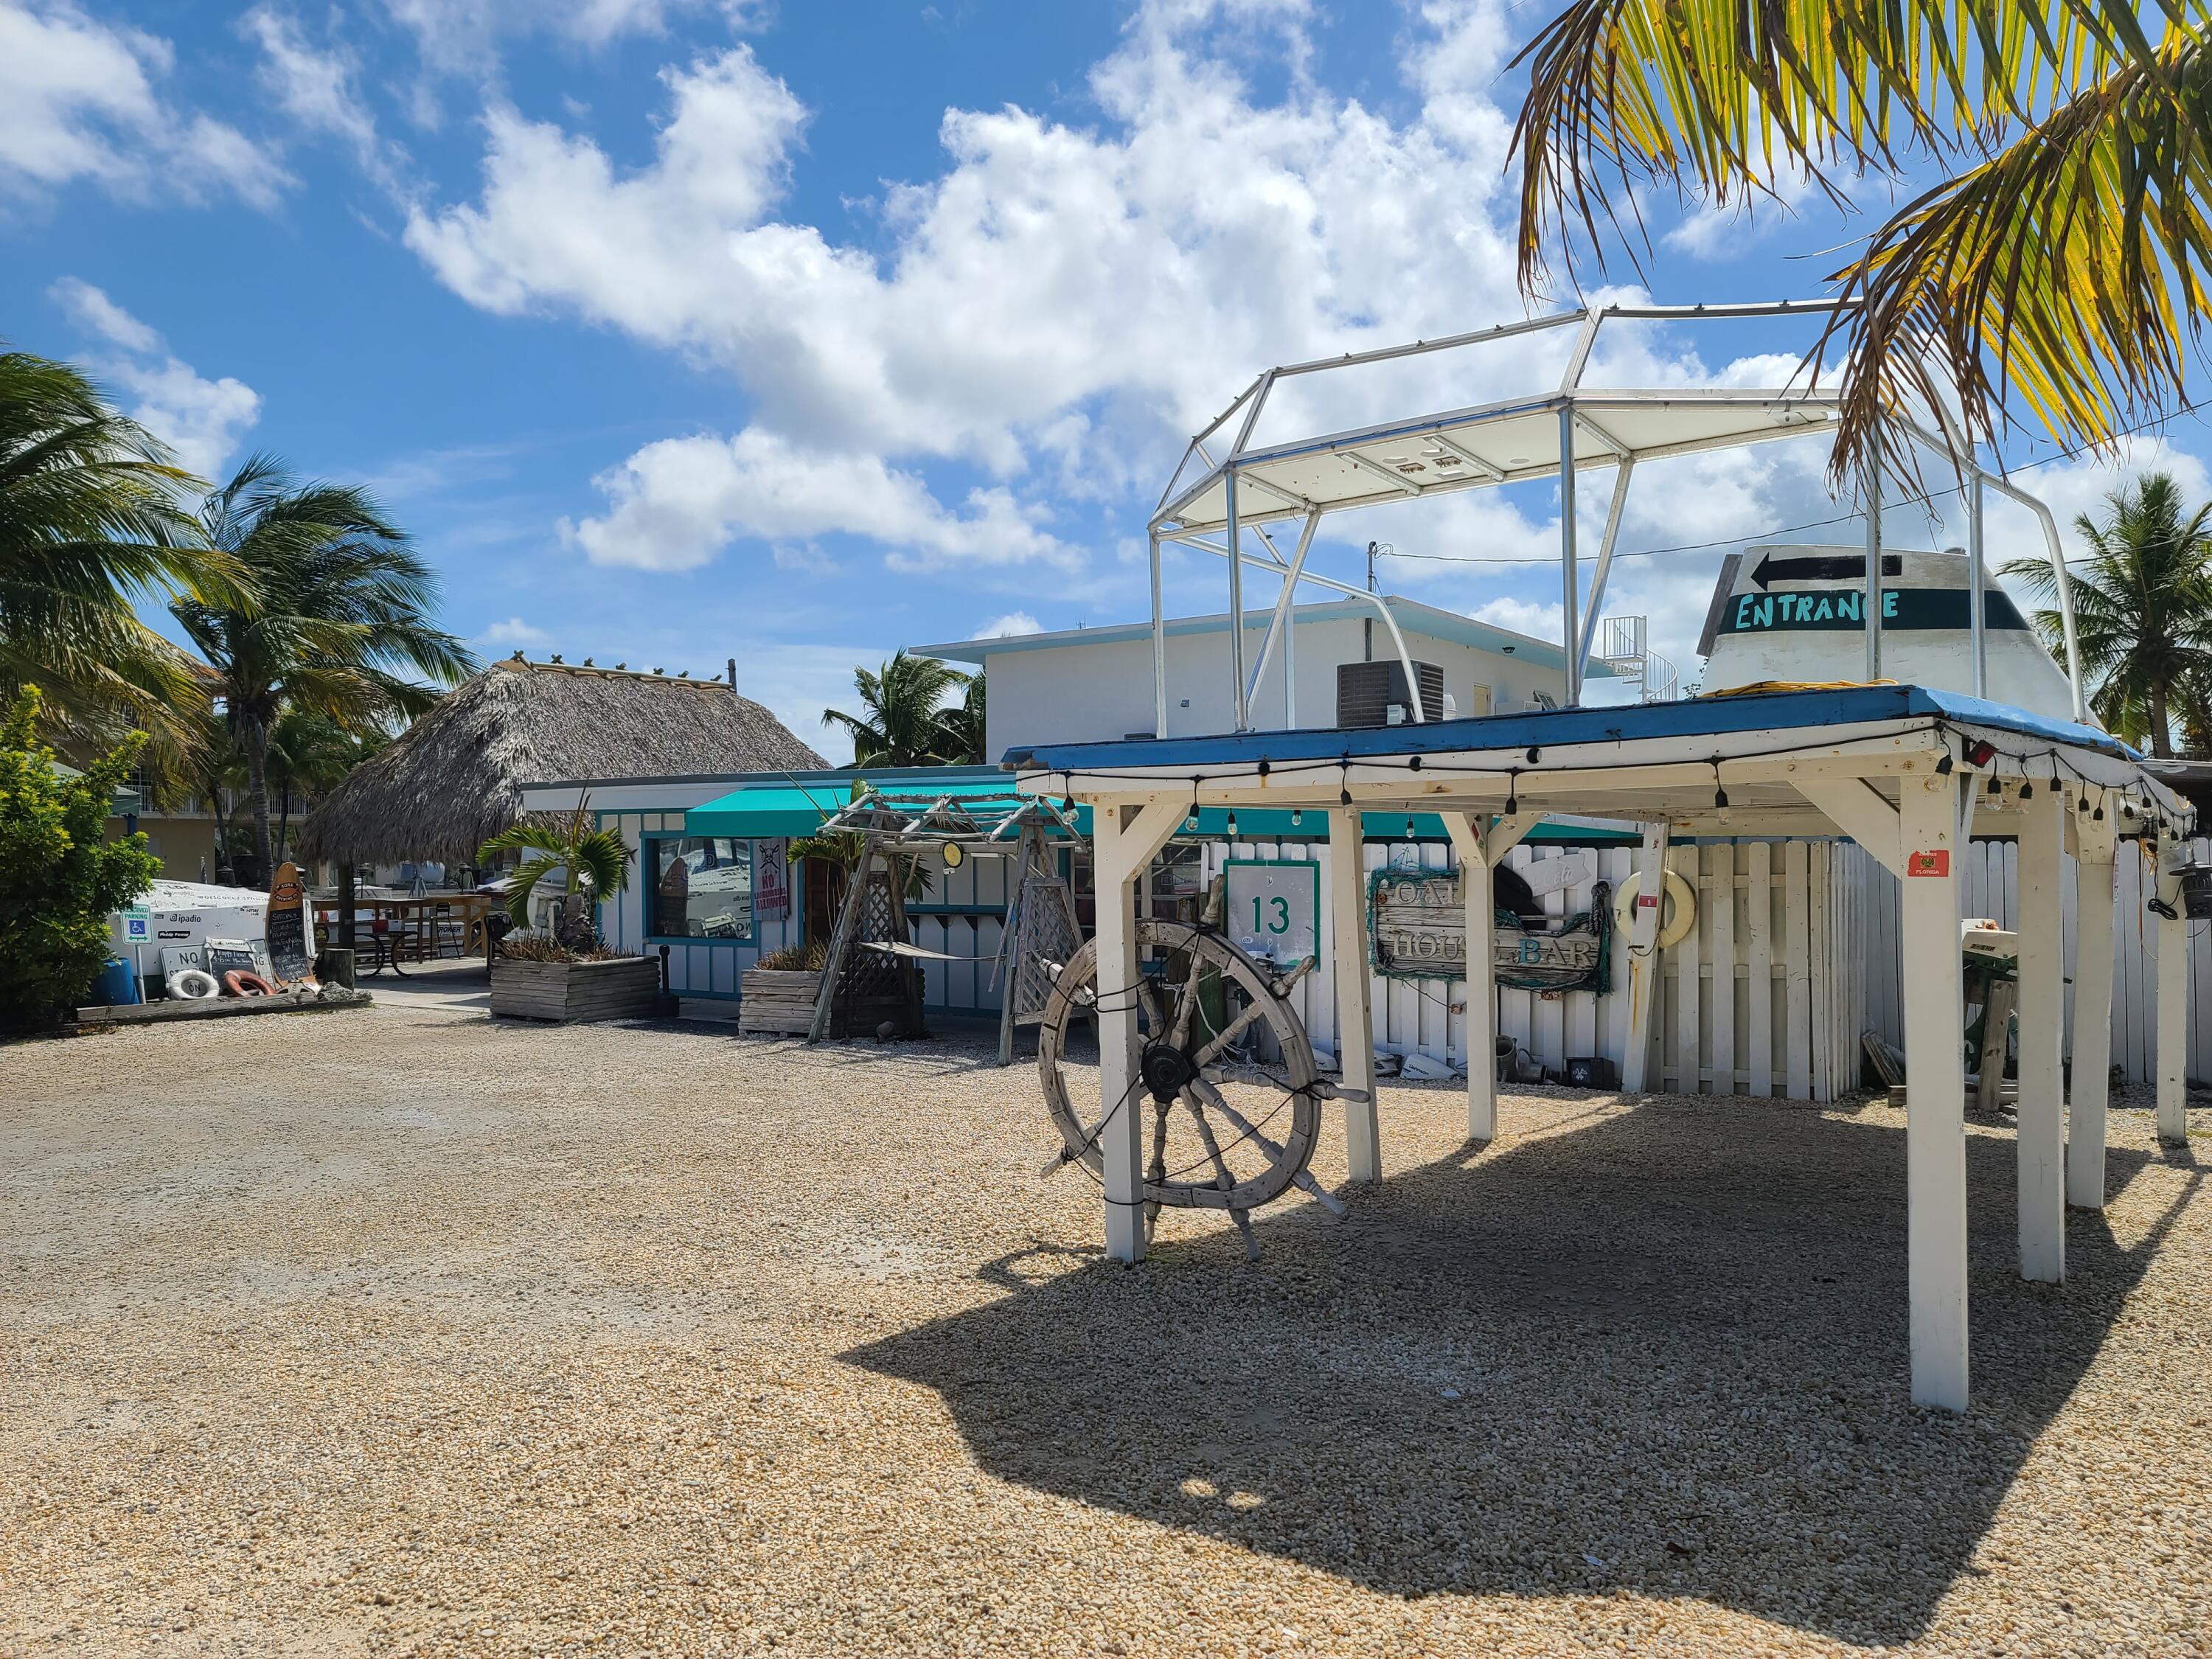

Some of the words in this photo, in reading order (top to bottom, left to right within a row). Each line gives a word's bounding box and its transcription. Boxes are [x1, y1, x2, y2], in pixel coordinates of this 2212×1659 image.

[762, 874, 774, 890] NO
[756, 895, 787, 911] ALLOWED
[178, 914, 201, 924] ipadio
[1252, 896, 1289, 935] 13
[179, 952, 198, 965] NO
[1517, 938, 1595, 967] BAR
[189, 984, 201, 992] ON
